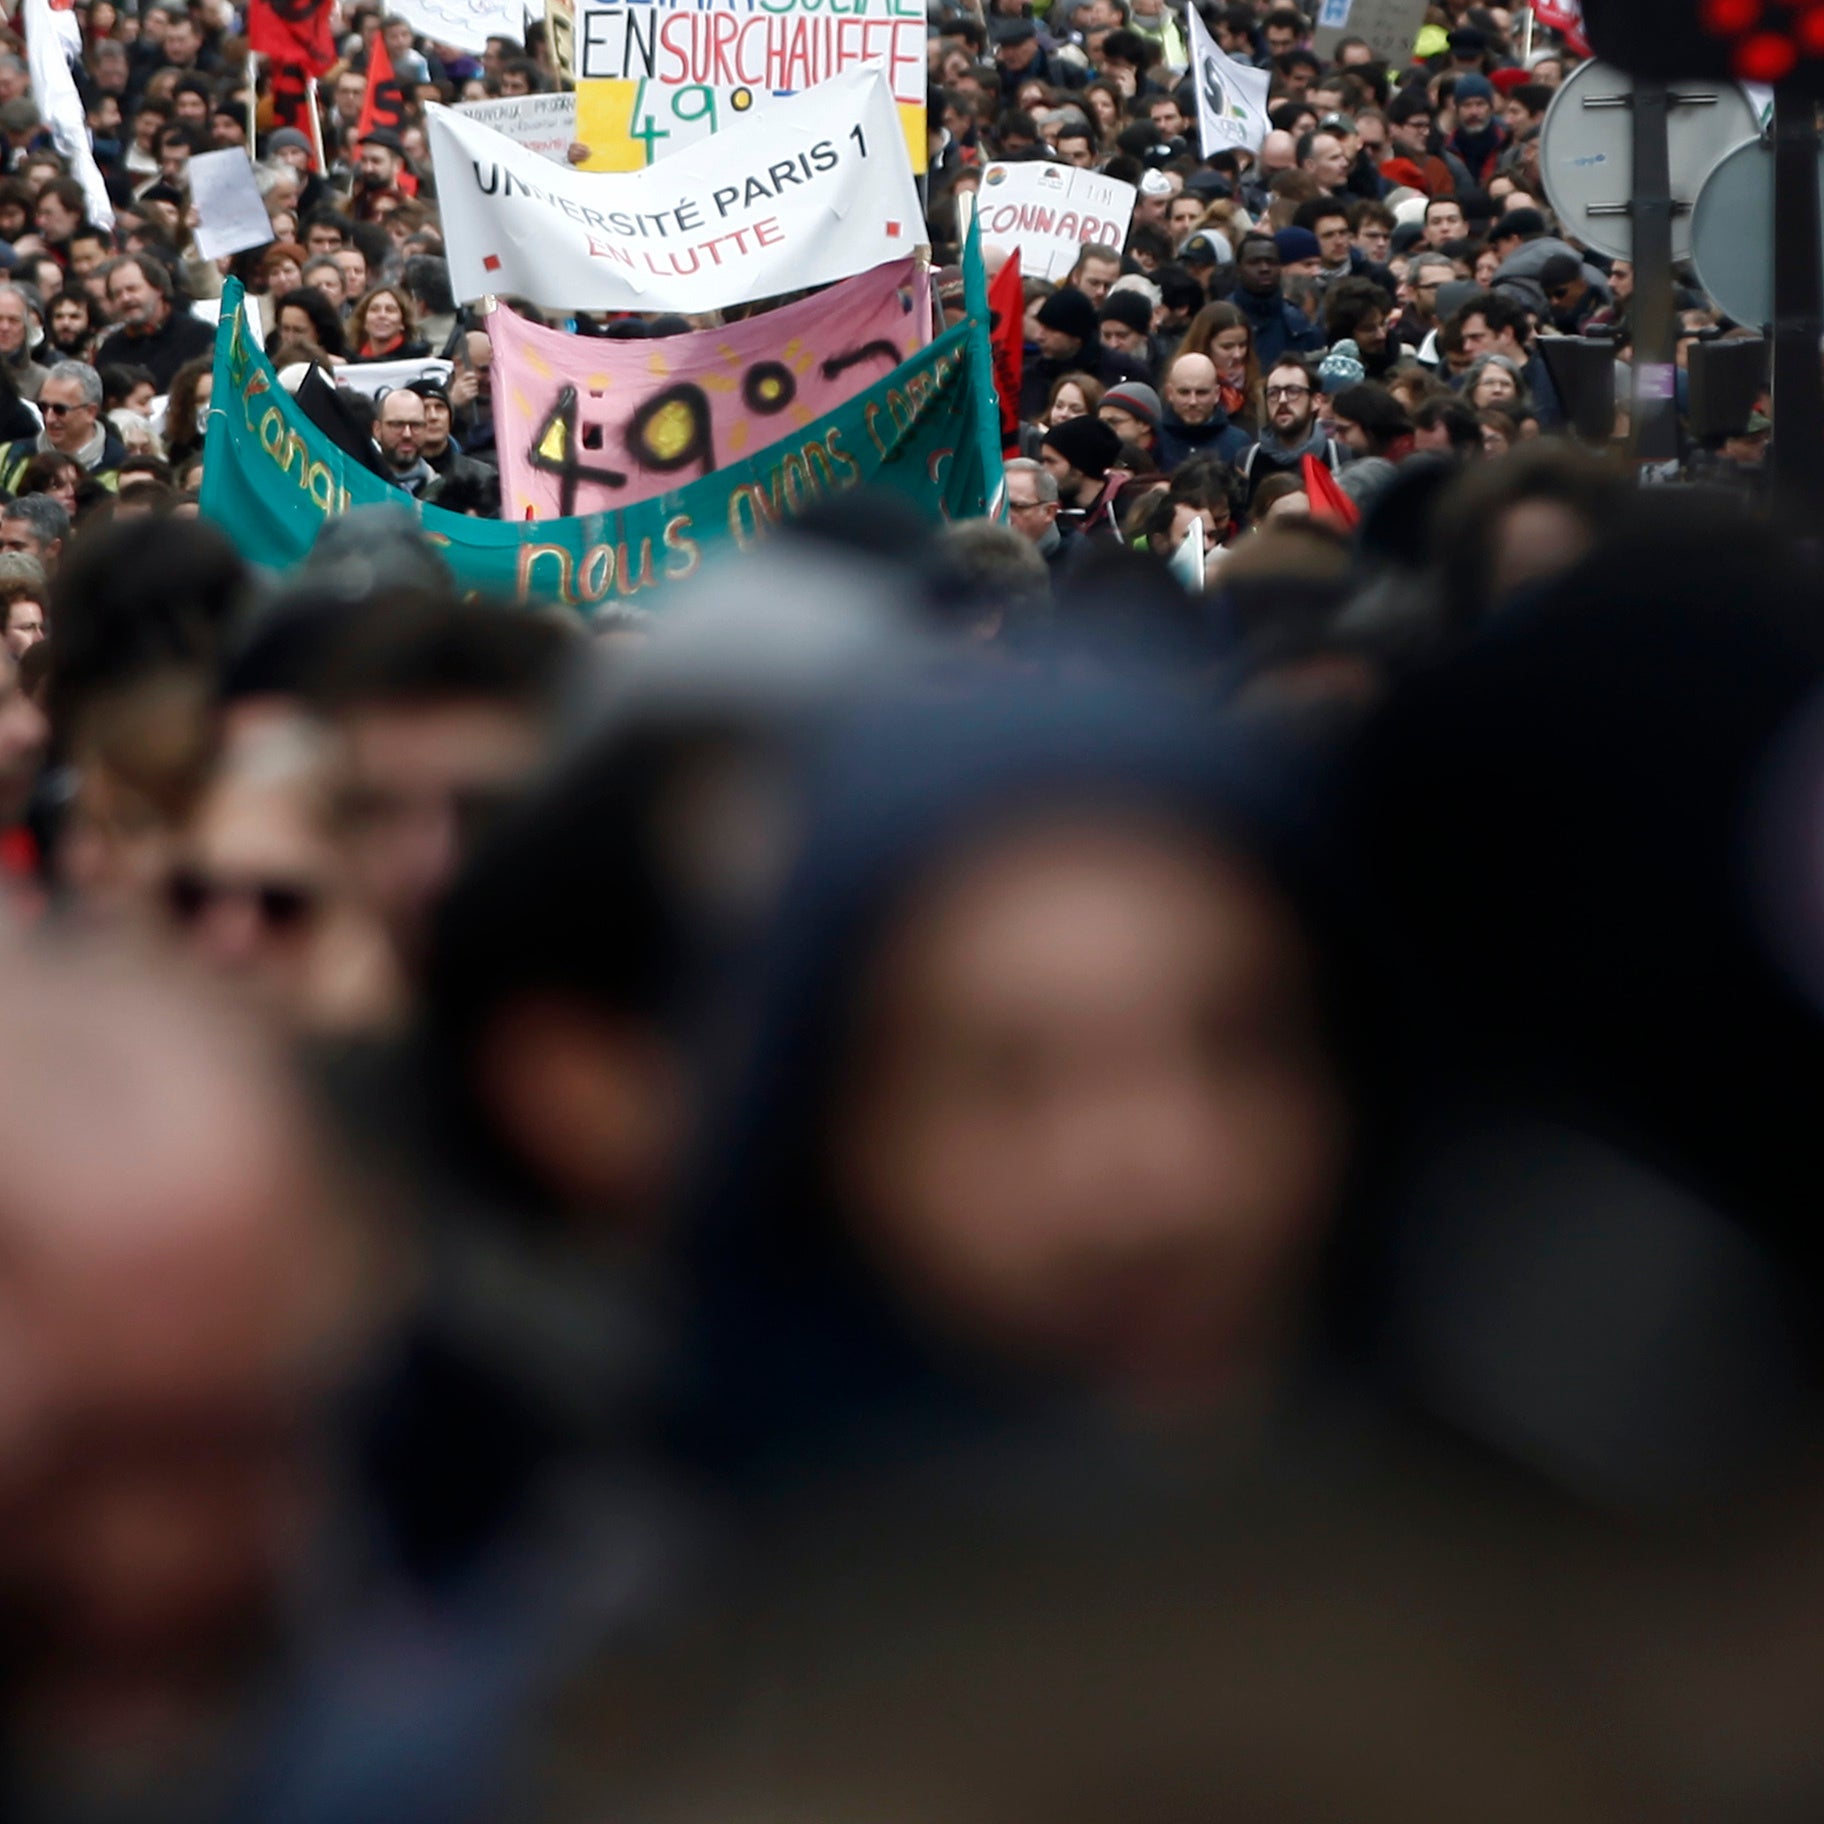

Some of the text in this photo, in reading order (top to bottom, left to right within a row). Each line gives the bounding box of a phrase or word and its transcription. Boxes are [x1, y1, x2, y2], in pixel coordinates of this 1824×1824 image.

[582, 7, 926, 104] EN SURCHAUFFE
[472, 123, 869, 238] UNIVERSITÉ PARIS 1
[978, 202, 1122, 249] CONNARD
[587, 215, 786, 278] EN LUTTE
[515, 514, 702, 607] nous
[728, 427, 862, 553] avons
